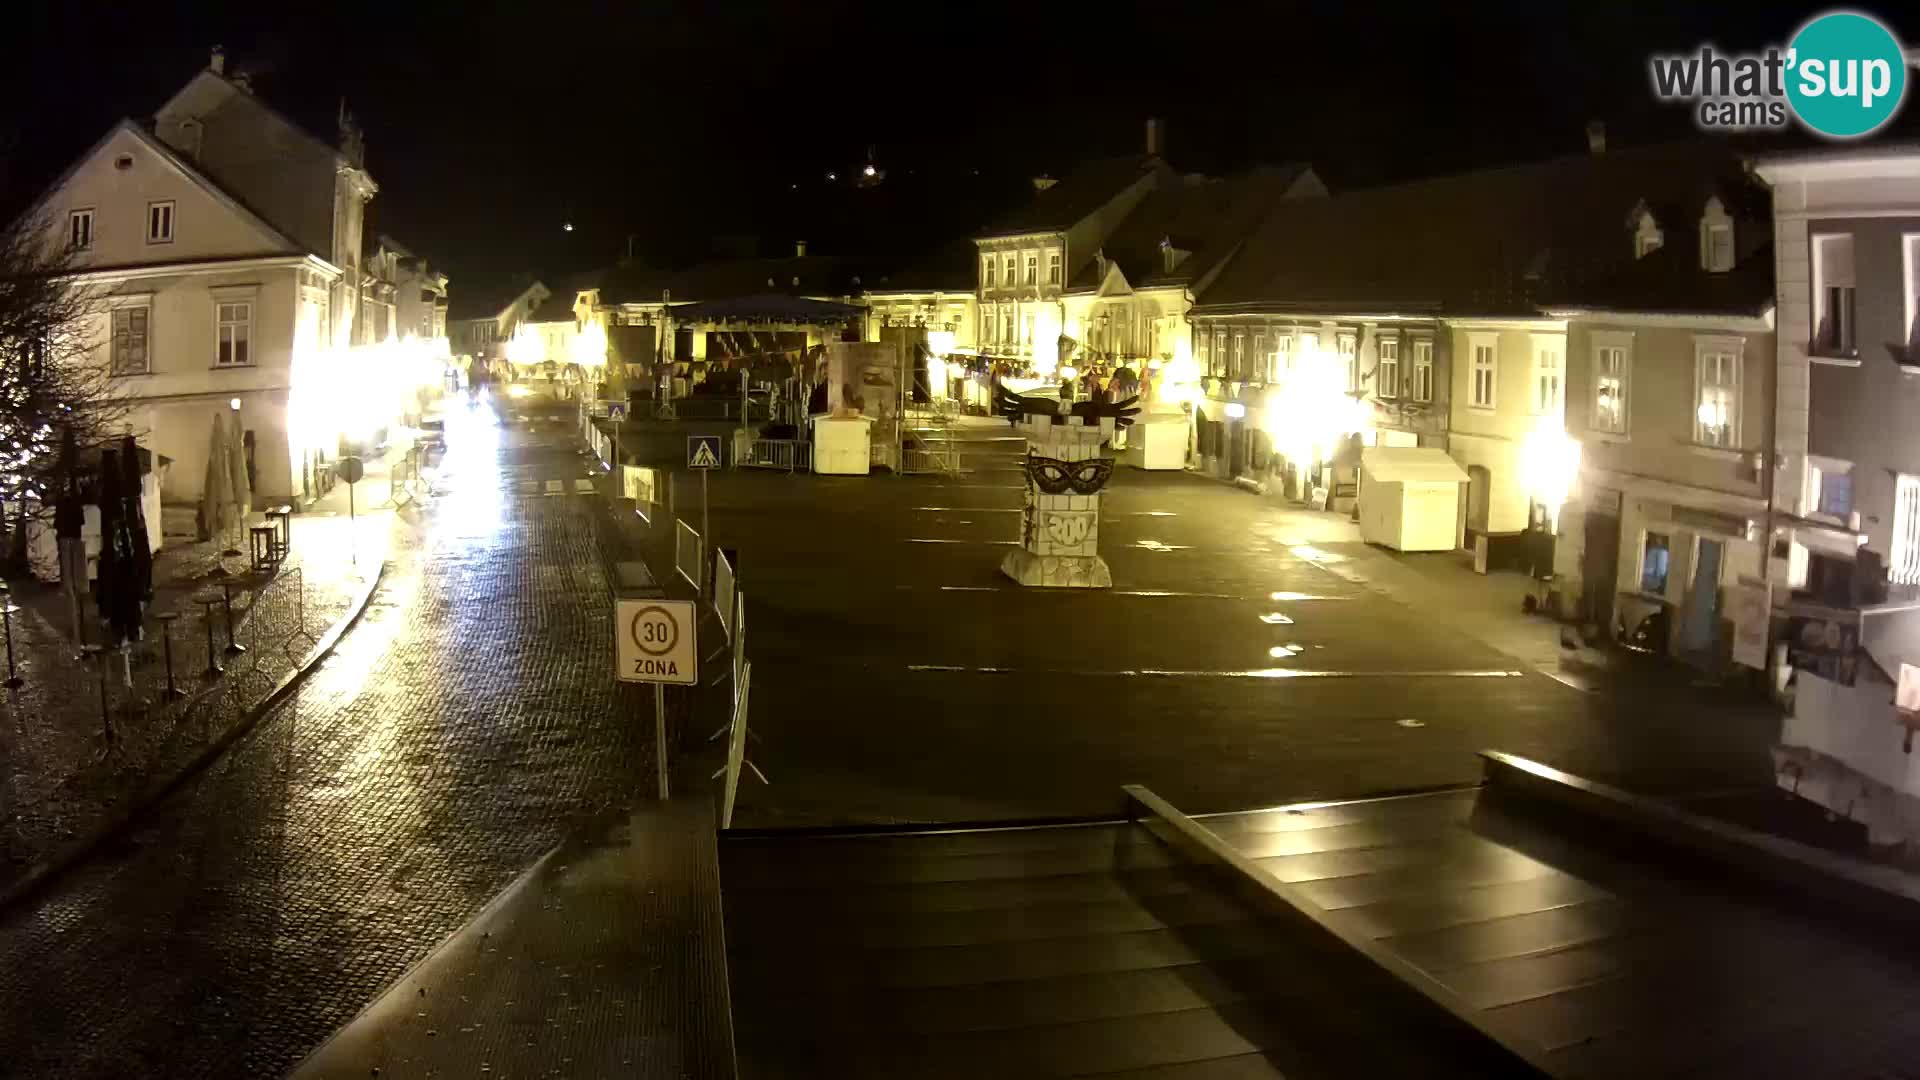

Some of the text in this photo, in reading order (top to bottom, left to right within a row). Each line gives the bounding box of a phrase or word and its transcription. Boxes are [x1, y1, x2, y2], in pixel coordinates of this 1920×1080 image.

[1049, 516, 1087, 545] 200
[644, 622, 667, 643] 30
[634, 659, 678, 676] ZONA
